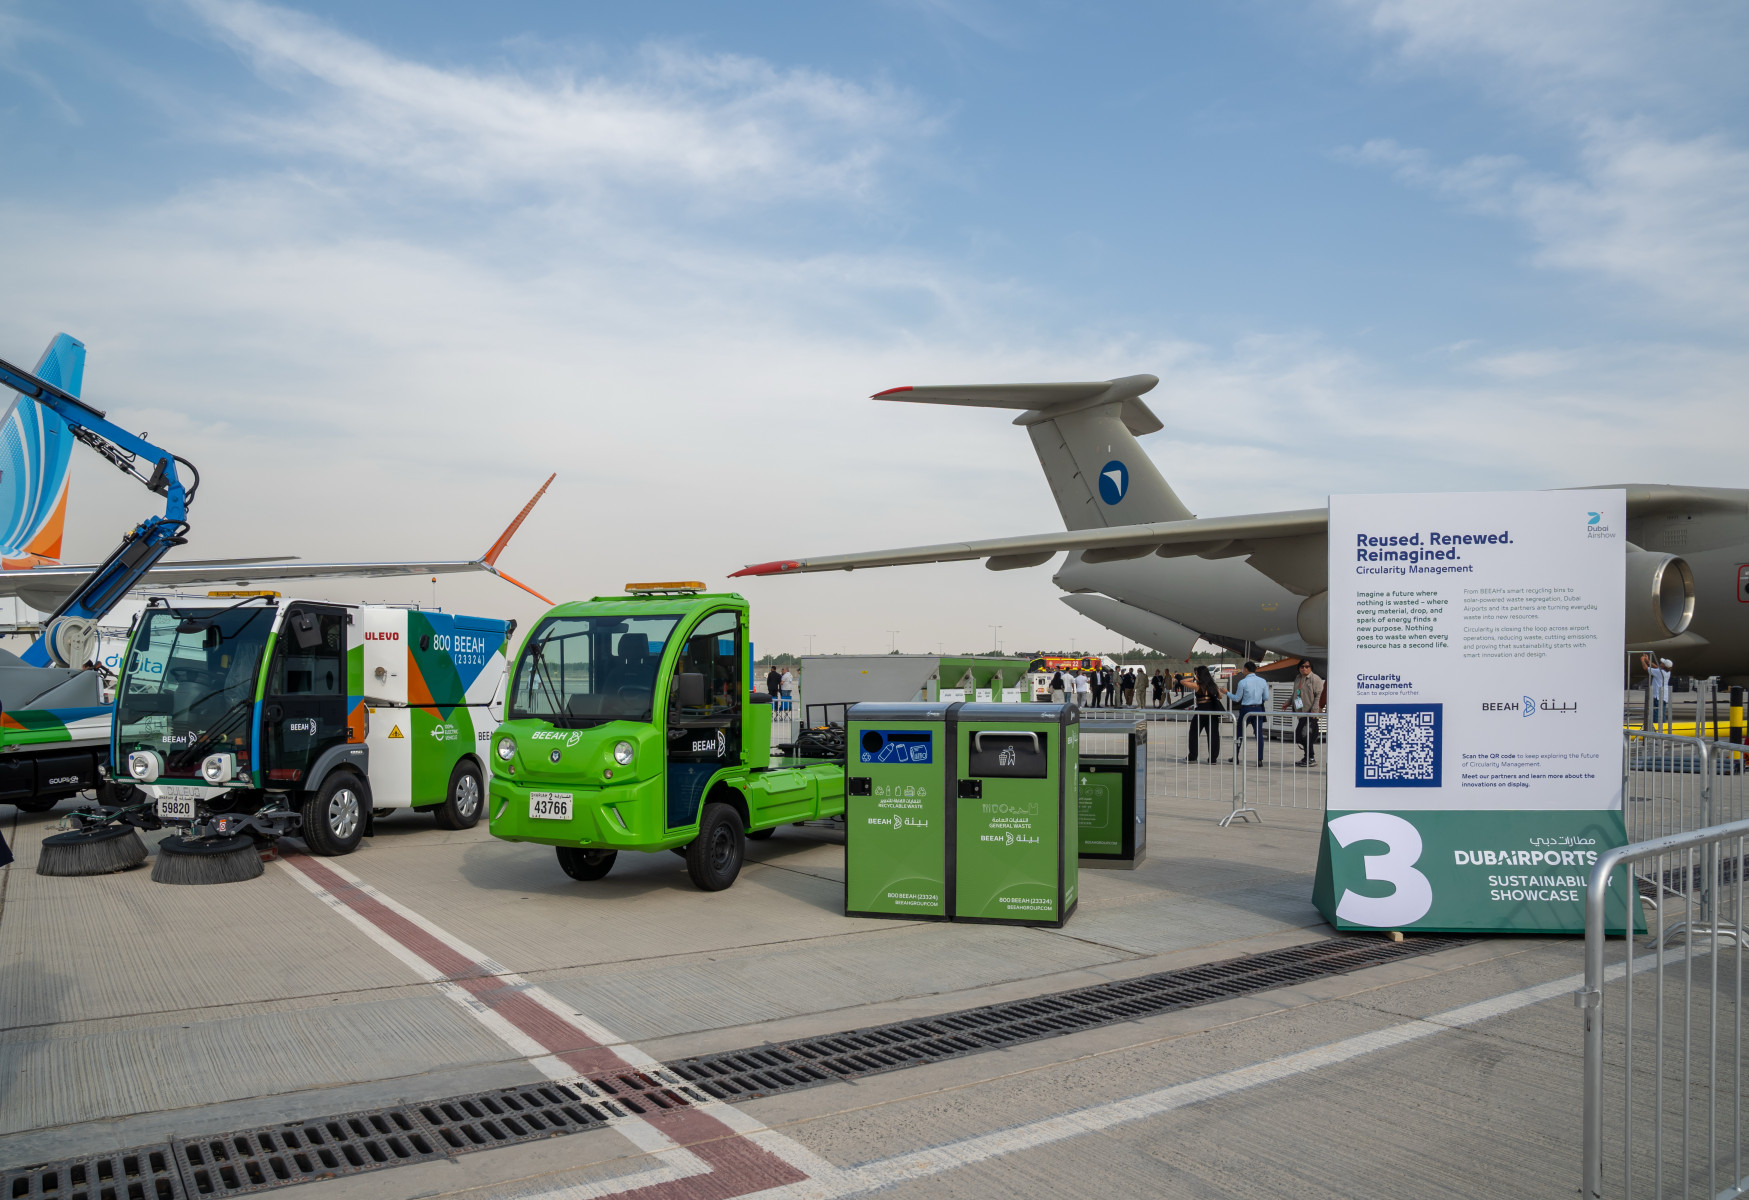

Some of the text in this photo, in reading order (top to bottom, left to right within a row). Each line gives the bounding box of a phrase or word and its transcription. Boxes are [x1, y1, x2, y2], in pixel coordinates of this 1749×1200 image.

[1357, 531, 1513, 546] Reused. Renewed.
[1357, 547, 1460, 563] Reimagined.
[1356, 565, 1473, 575] Circularity Management
[365, 632, 399, 640] ULEVO
[434, 634, 484, 653] 800 BEEAH
[455, 654, 484, 666] (23324)
[1357, 674, 1400, 682] Circularity
[1357, 682, 1412, 690] Management
[532, 732, 568, 740] BEEAH
[692, 740, 716, 751] BEEAH
[162, 802, 190, 814] 59820
[535, 801, 567, 814] 43766
[1530, 837, 1557, 846] دبي
[1328, 812, 1432, 927] 3
[1488, 876, 1613, 886] SUSTAINABILY
[1490, 890, 1579, 901] SHOWCASE
